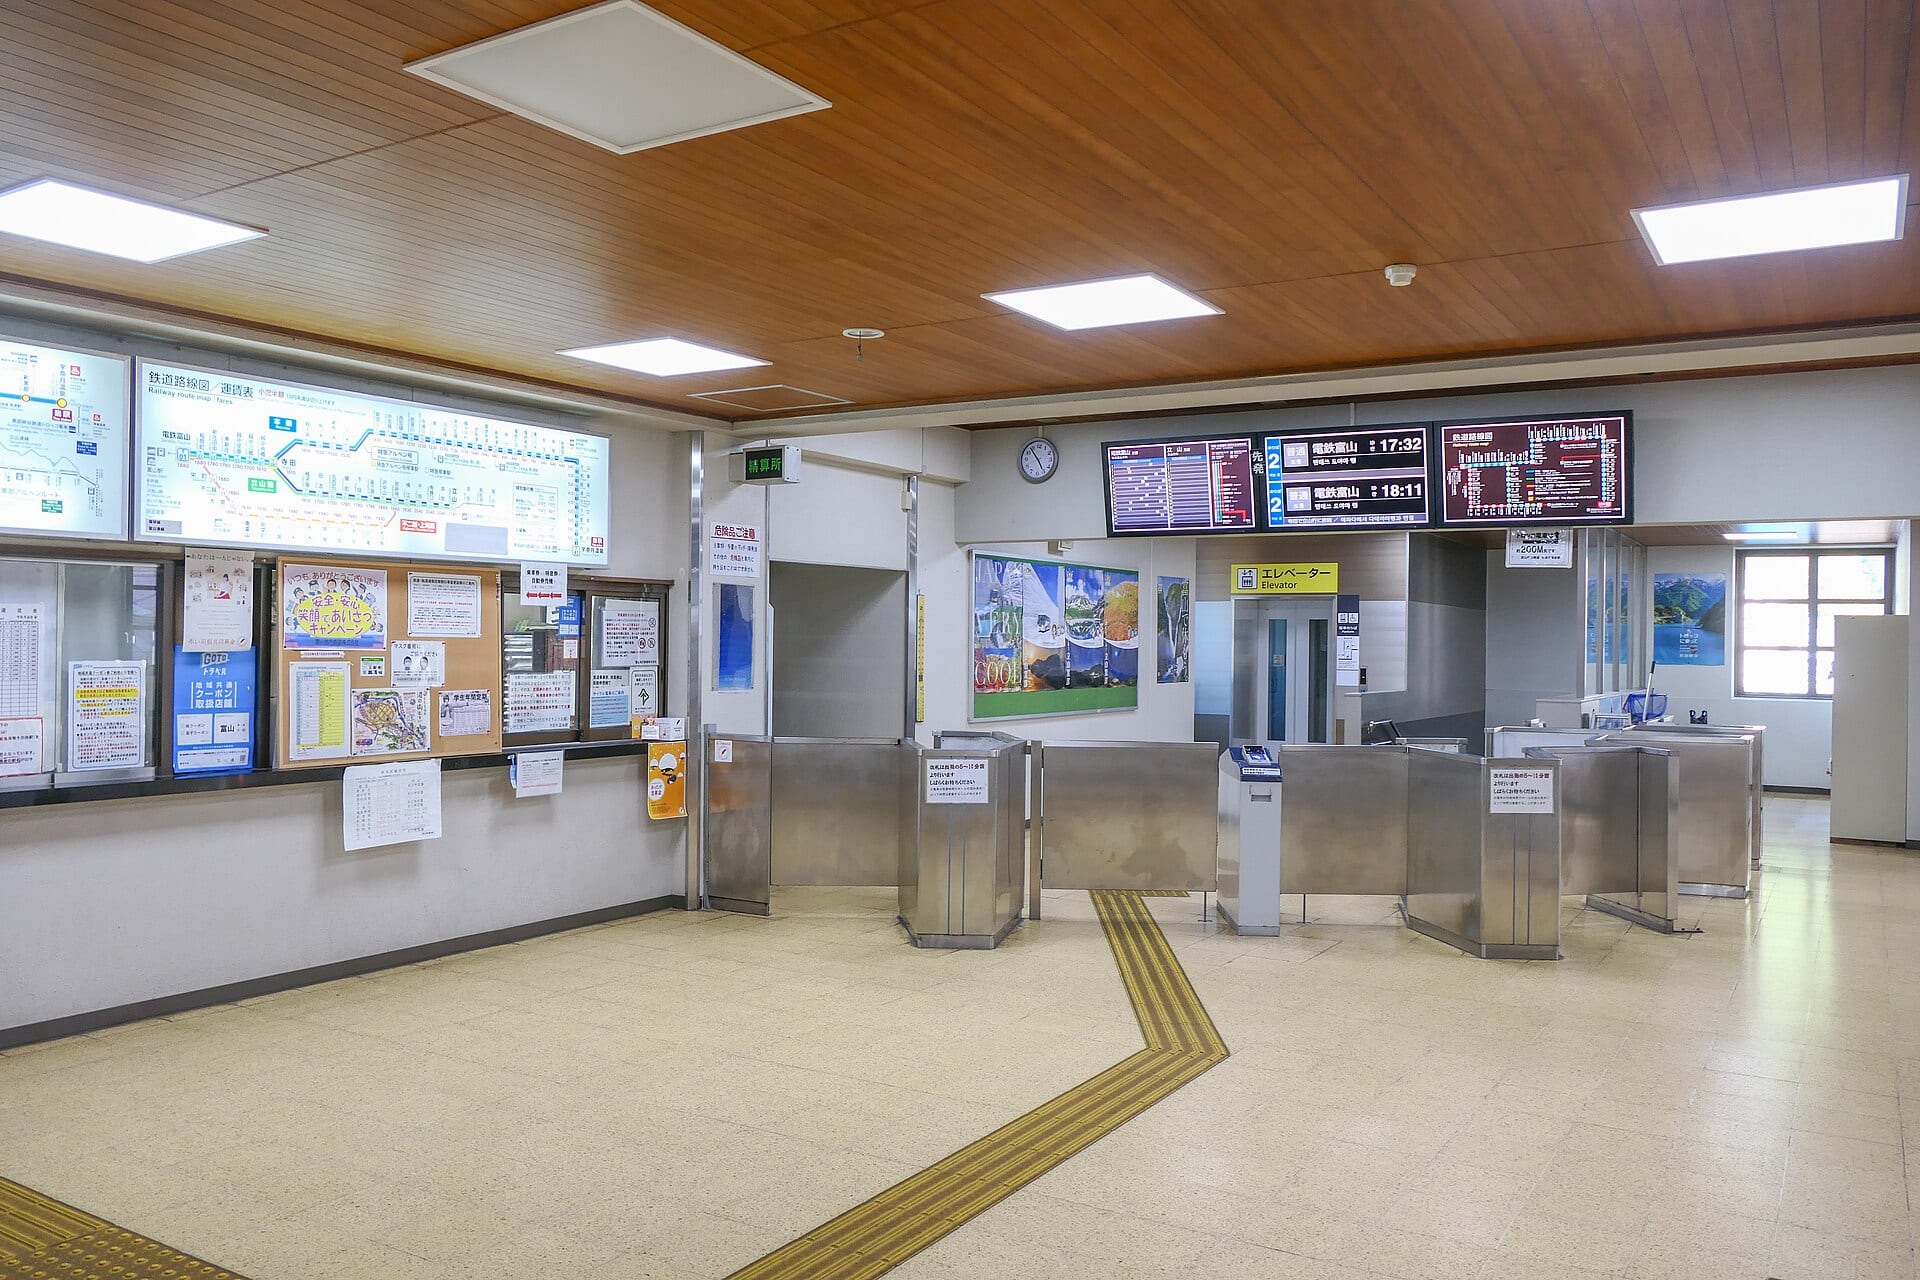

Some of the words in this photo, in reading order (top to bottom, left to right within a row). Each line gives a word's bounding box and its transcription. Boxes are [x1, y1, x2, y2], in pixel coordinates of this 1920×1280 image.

[148, 371, 209, 392] 鉄道路線図
[221, 382, 254, 398] 運賃表
[148, 387, 176, 398] Railway
[216, 396, 232, 404] fares
[1312, 441, 1358, 455] 電鉄富山
[1380, 438, 1422, 452] 17:32
[749, 458, 781, 473] 精算所
[1252, 450, 1264, 474] 先発
[1268, 454, 1279, 469] 2
[1314, 486, 1359, 499] 電鉄富山
[1381, 483, 1422, 497] 18:11
[1270, 497, 1282, 512] 2
[715, 525, 755, 539] 危険品ご注意
[1261, 567, 1331, 579] エレベーター
[1261, 581, 1297, 589] Elevator
[312, 594, 360, 610] 安全・安心
[298, 608, 372, 623] 笑顔であいさつ
[976, 610, 1022, 636] VERY
[310, 623, 363, 635] キャンペーン
[204, 668, 226, 676] トラベル
[975, 661, 1022, 686] COOL
[196, 689, 232, 698] クーポン
[454, 694, 487, 702] 学生年間定期
[196, 699, 232, 708] 取扱店舗
[220, 724, 234, 733] 富山
